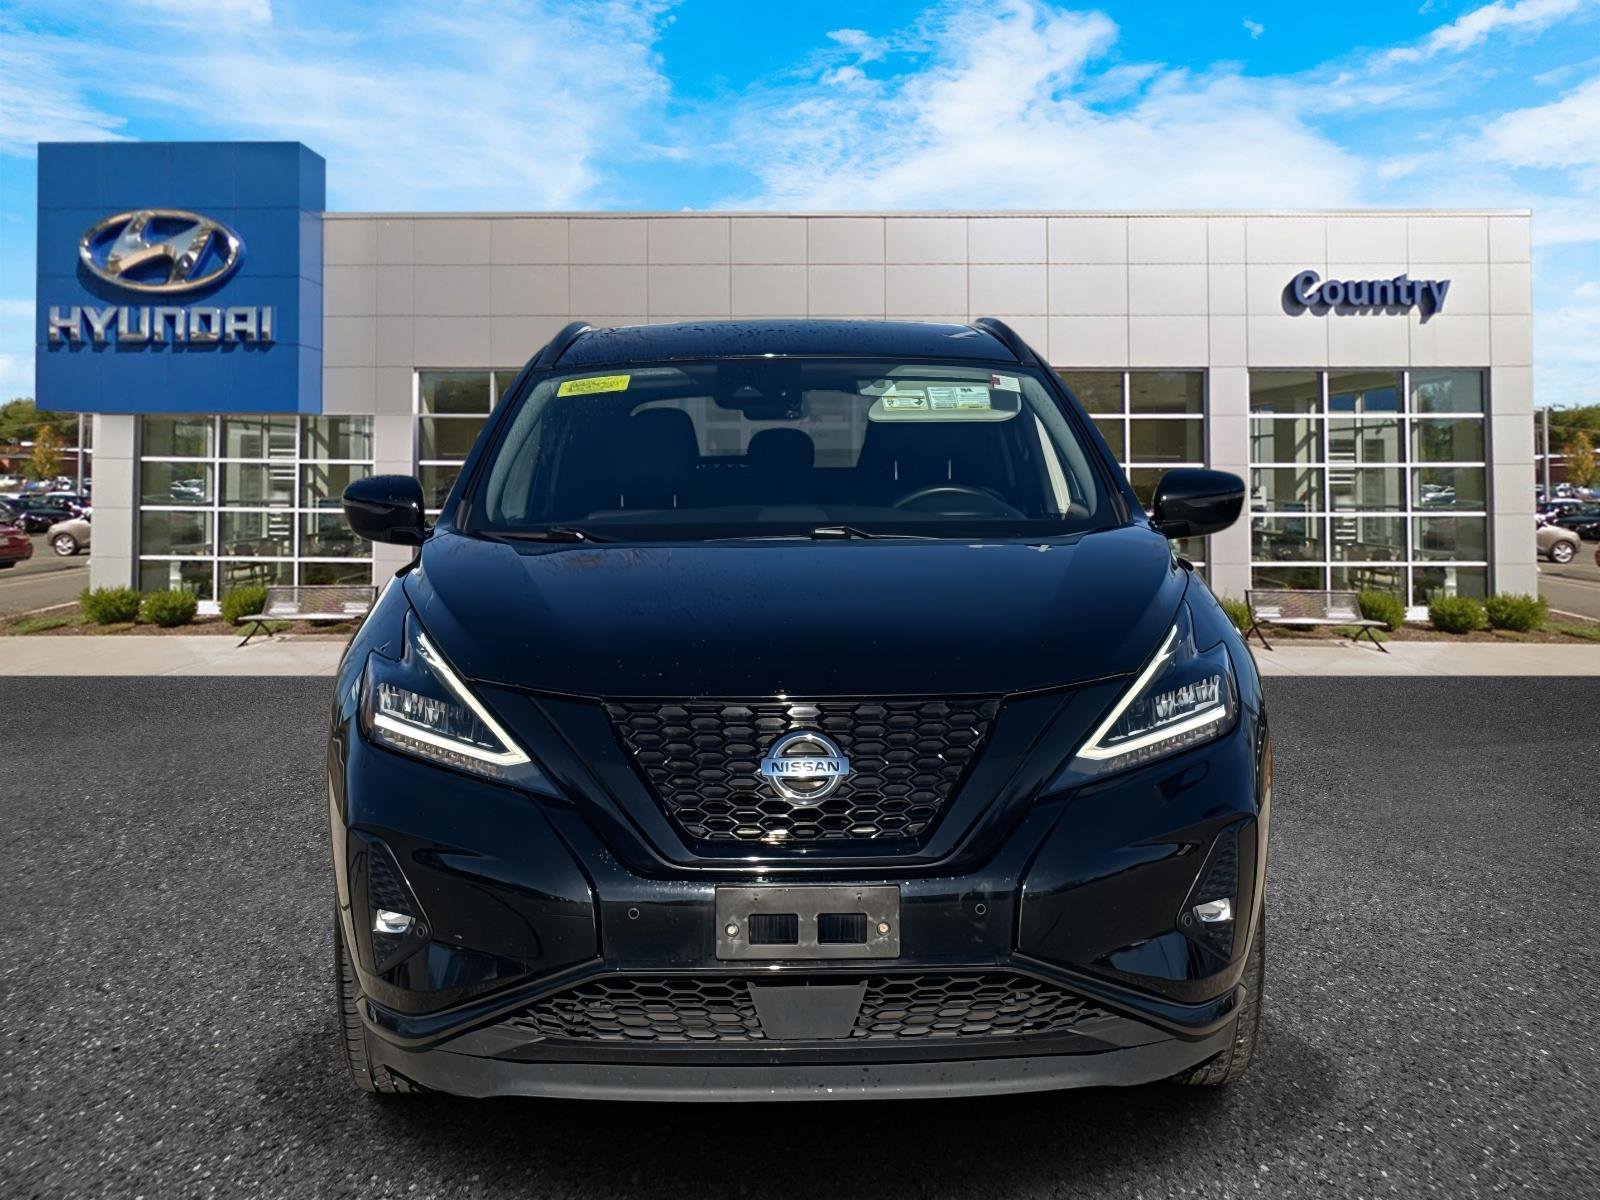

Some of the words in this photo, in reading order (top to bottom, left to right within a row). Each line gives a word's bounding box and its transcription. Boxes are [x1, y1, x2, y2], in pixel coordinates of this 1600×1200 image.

[1283, 269, 1452, 323] Country
[48, 305, 273, 345] HYUNDAI
[771, 760, 840, 774] NISSAN
